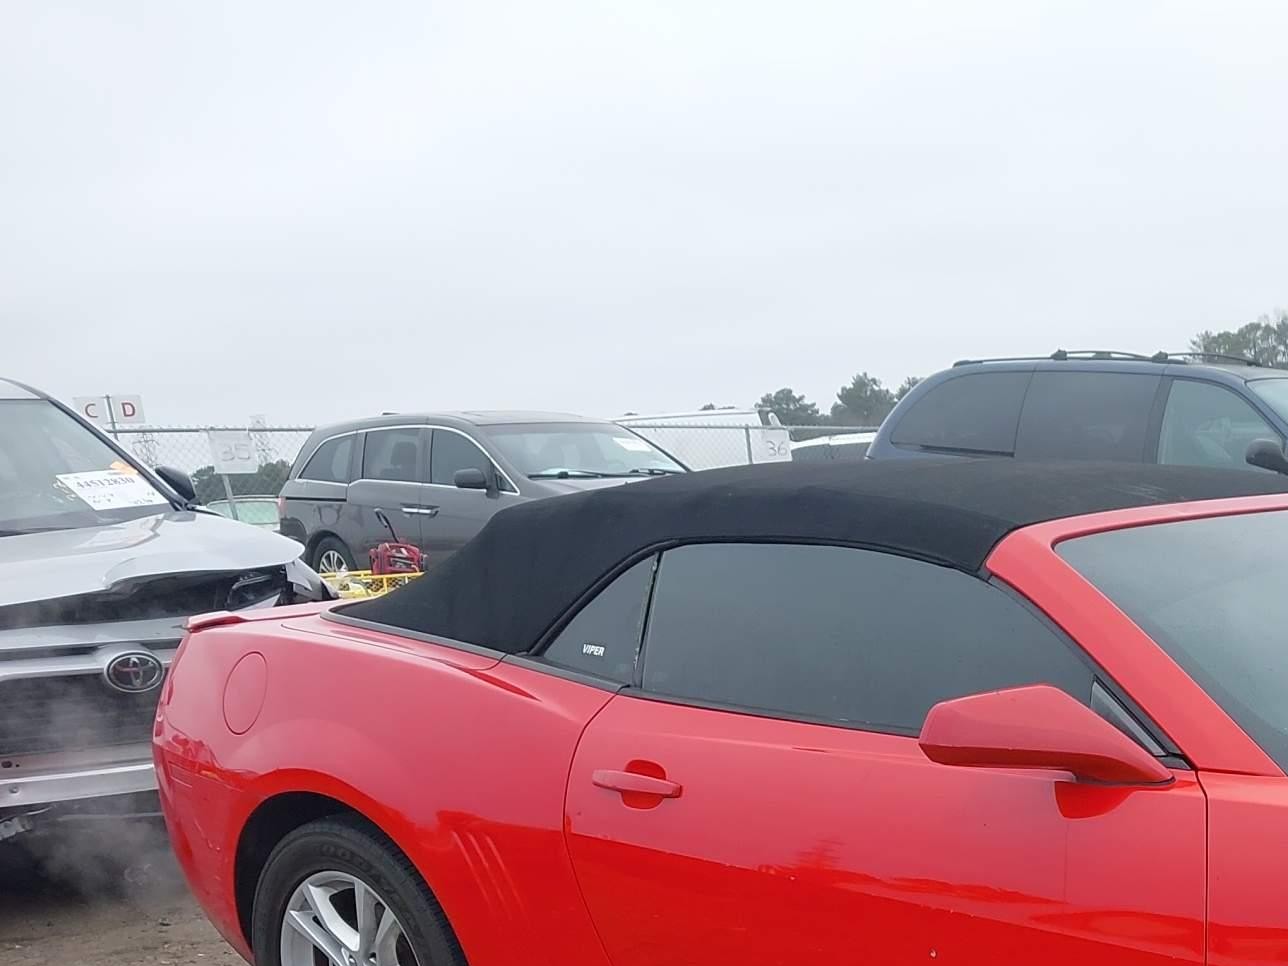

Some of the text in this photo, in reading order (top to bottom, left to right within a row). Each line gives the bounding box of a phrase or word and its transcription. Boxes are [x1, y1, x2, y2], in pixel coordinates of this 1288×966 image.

[85, 404, 99, 418] C
[122, 403, 136, 417] D
[766, 440, 787, 456] 36
[582, 643, 605, 657] VIPER
